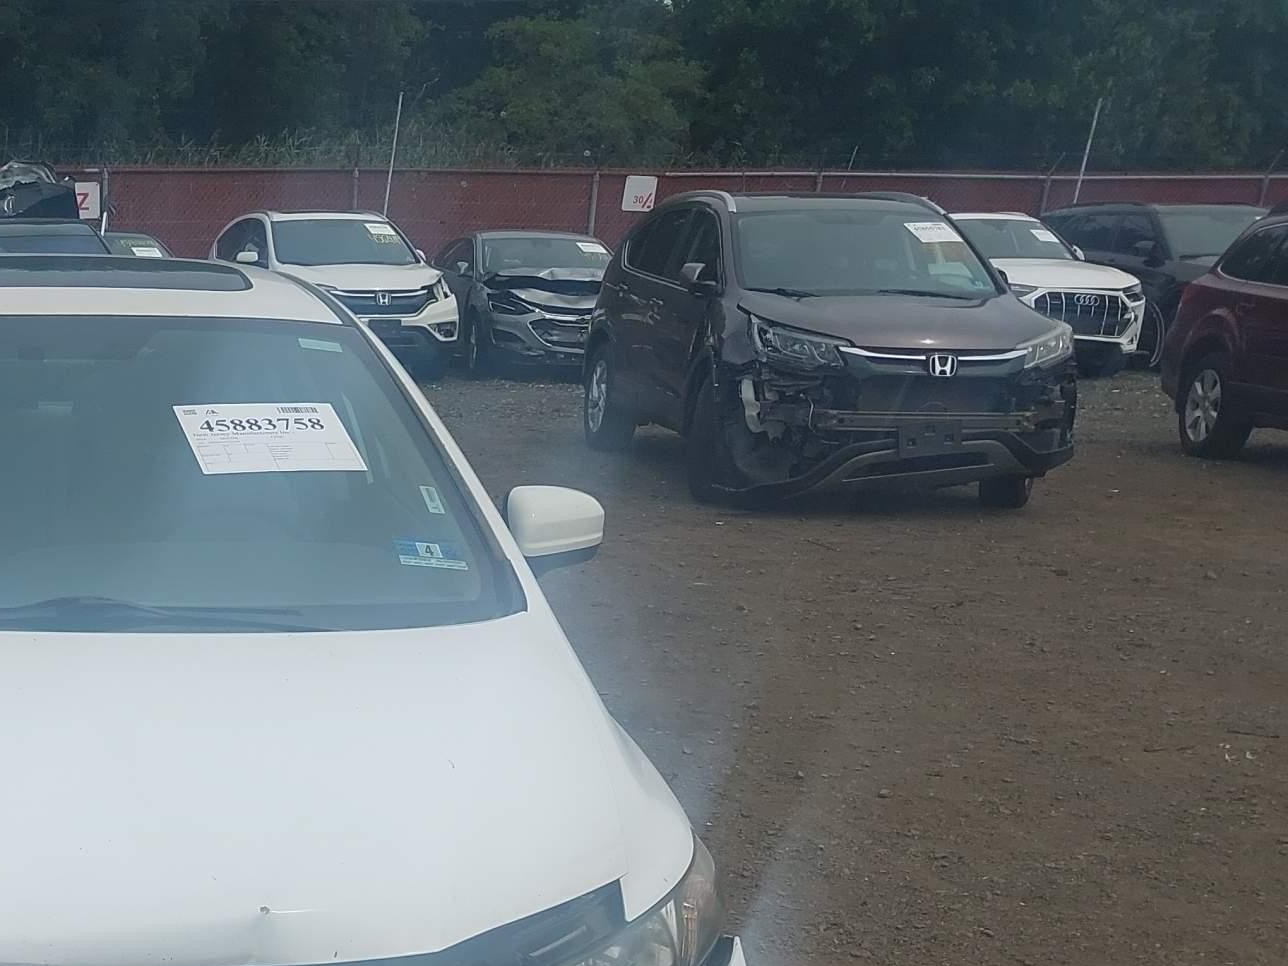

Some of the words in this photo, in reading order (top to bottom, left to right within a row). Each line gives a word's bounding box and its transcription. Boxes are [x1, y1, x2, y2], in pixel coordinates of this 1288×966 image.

[76, 192, 90, 210] Z
[199, 417, 325, 432] 45883758
[424, 545, 434, 556] 4
